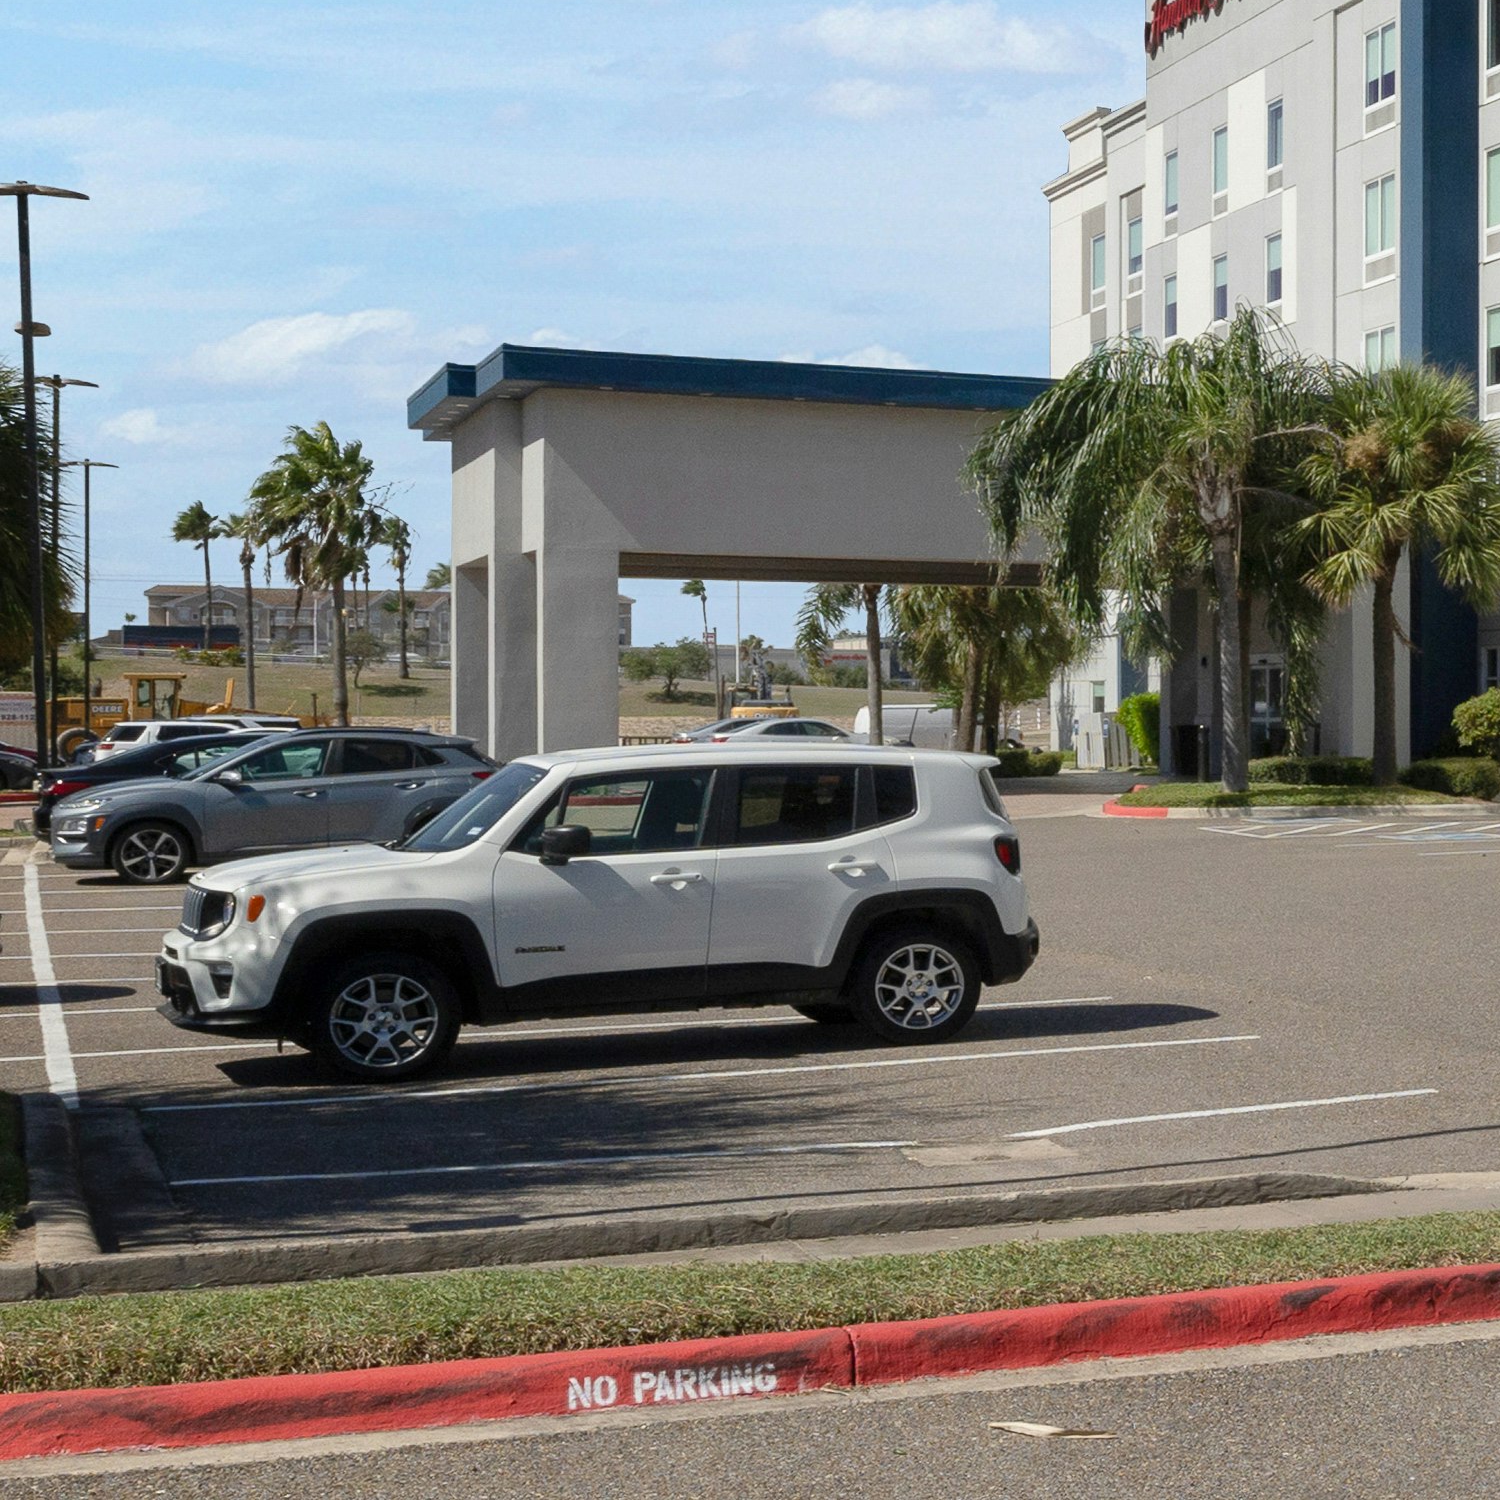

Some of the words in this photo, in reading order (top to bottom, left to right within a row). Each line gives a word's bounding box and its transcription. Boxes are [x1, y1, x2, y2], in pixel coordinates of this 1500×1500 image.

[92, 705, 123, 713] DEERE
[567, 1375, 618, 1410] NO
[632, 1362, 778, 1403] PARKING
